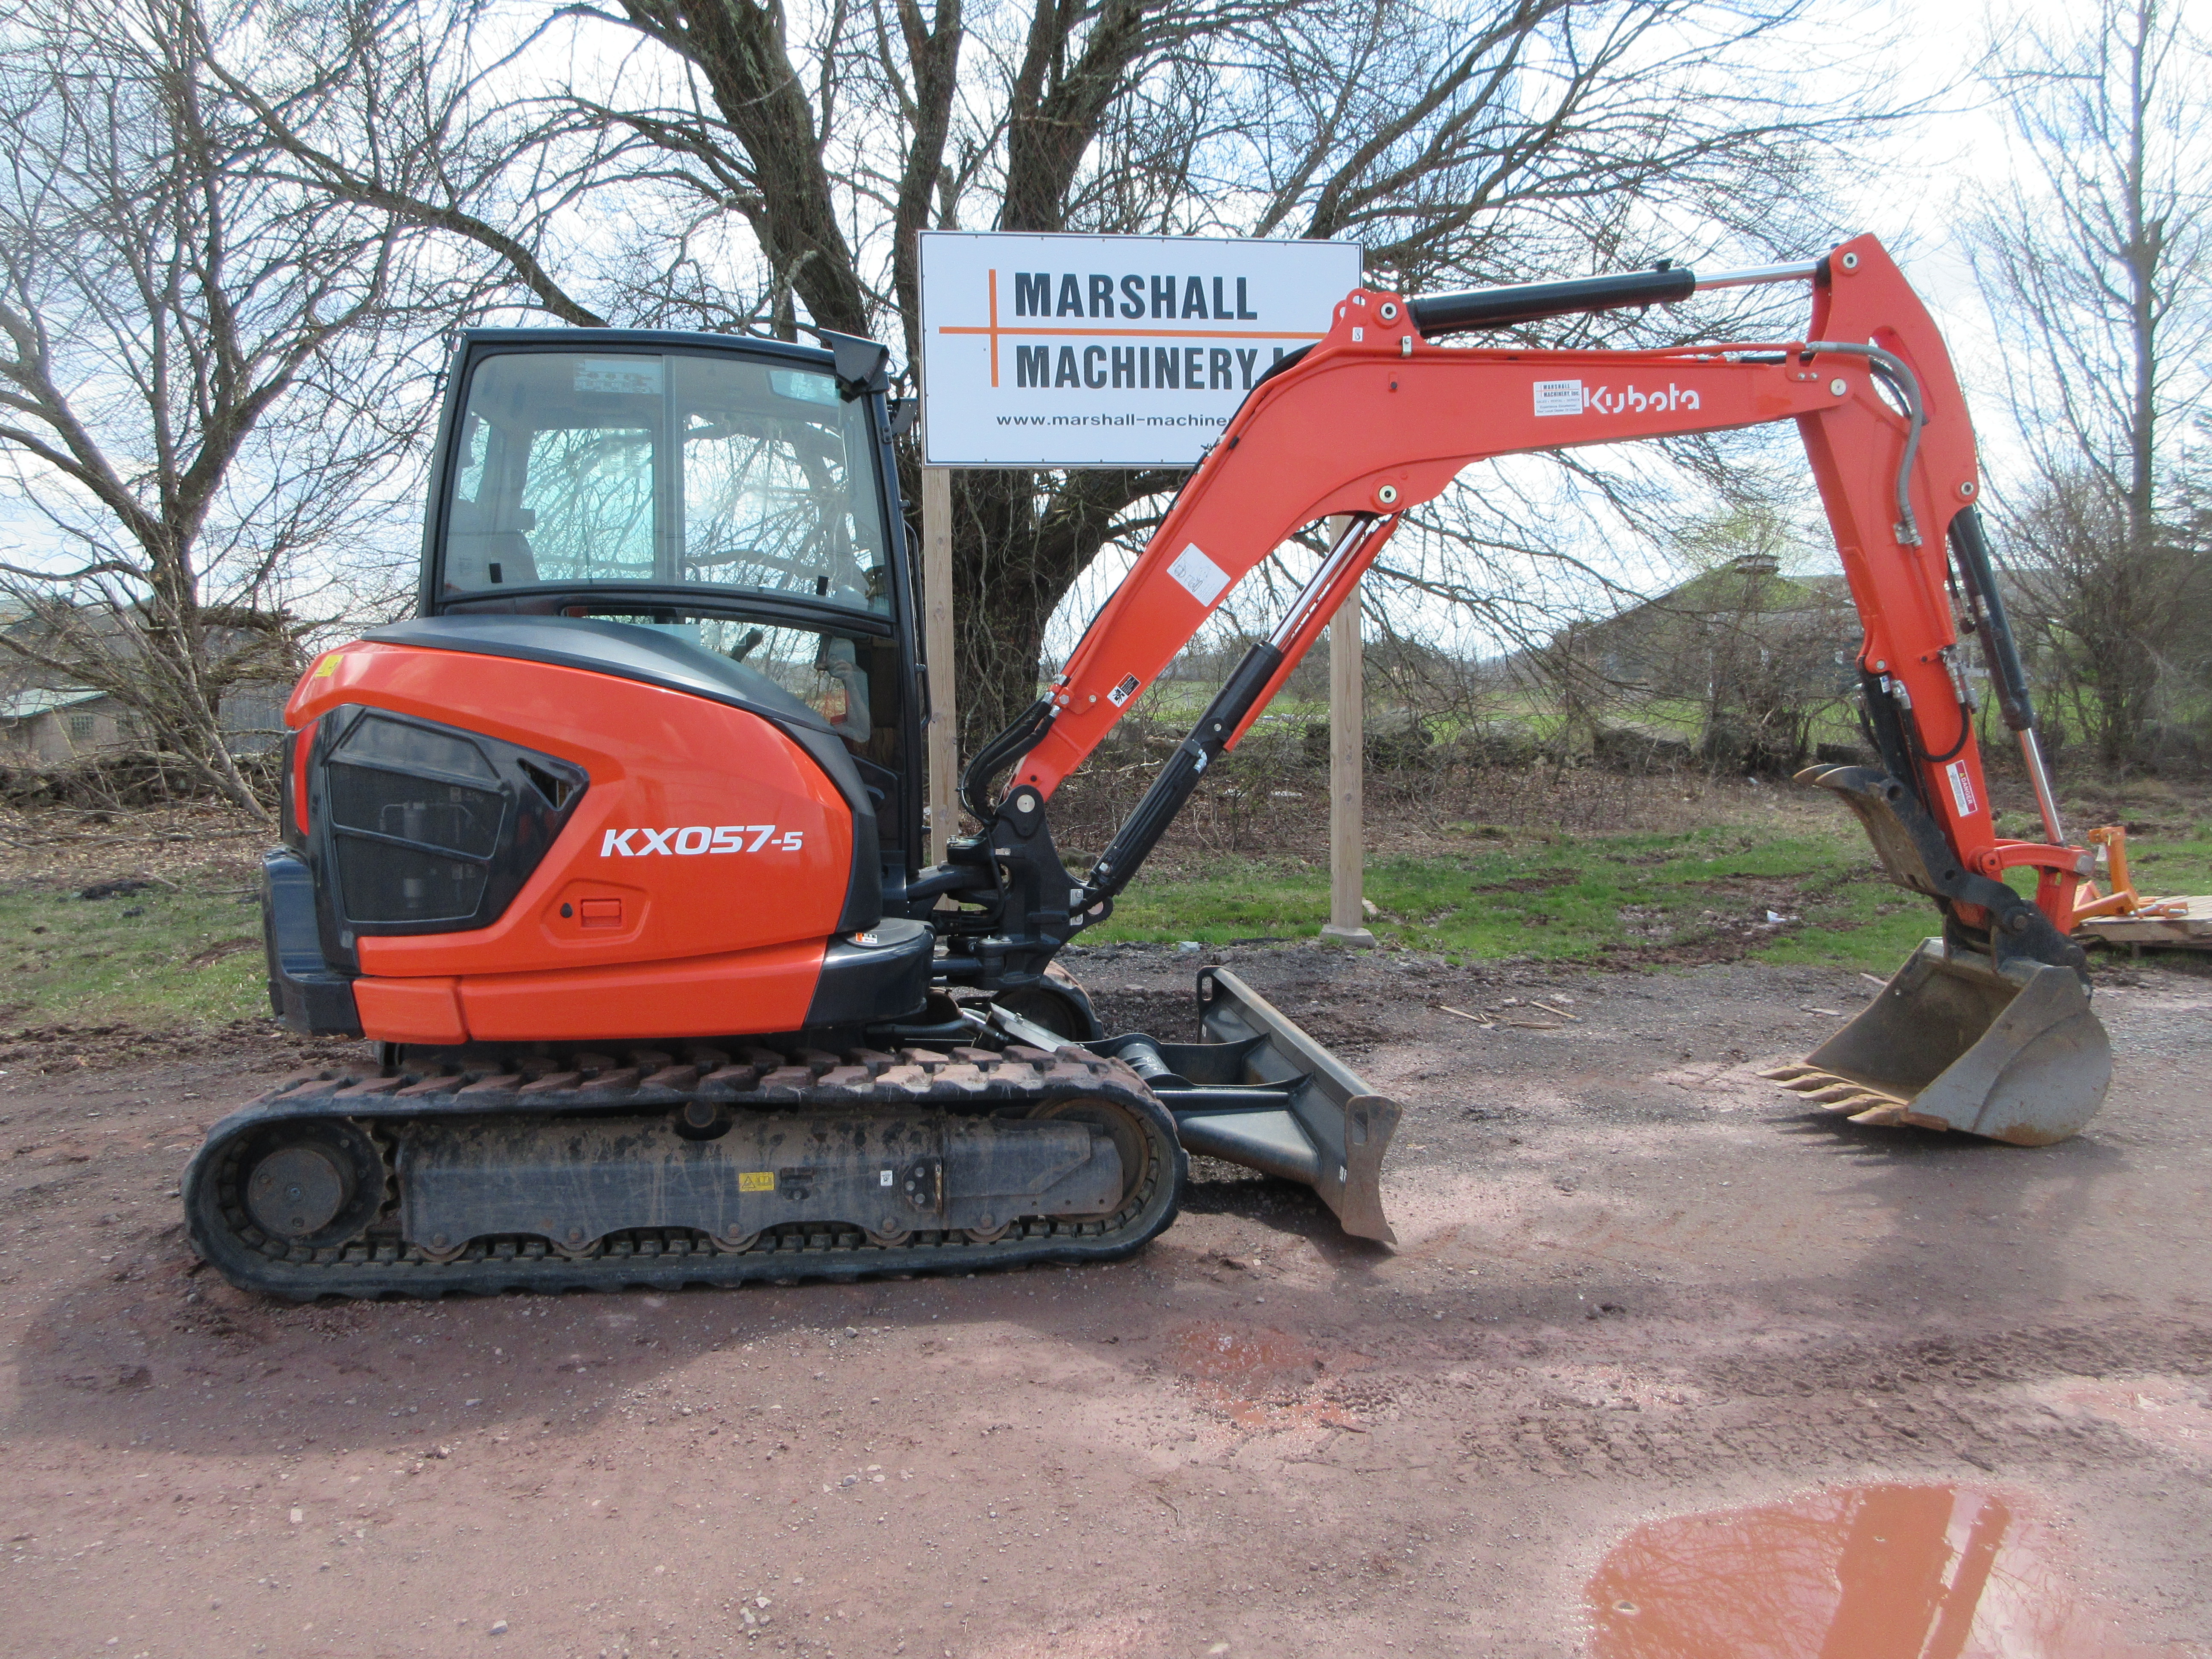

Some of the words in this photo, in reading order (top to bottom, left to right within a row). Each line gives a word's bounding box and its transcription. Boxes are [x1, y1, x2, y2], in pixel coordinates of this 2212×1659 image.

[1015, 272, 1257, 320] MARSHALL
[1583, 383, 1700, 413] Kubota
[1961, 777, 1973, 804] DANGER
[600, 825, 803, 857] KX057-5
